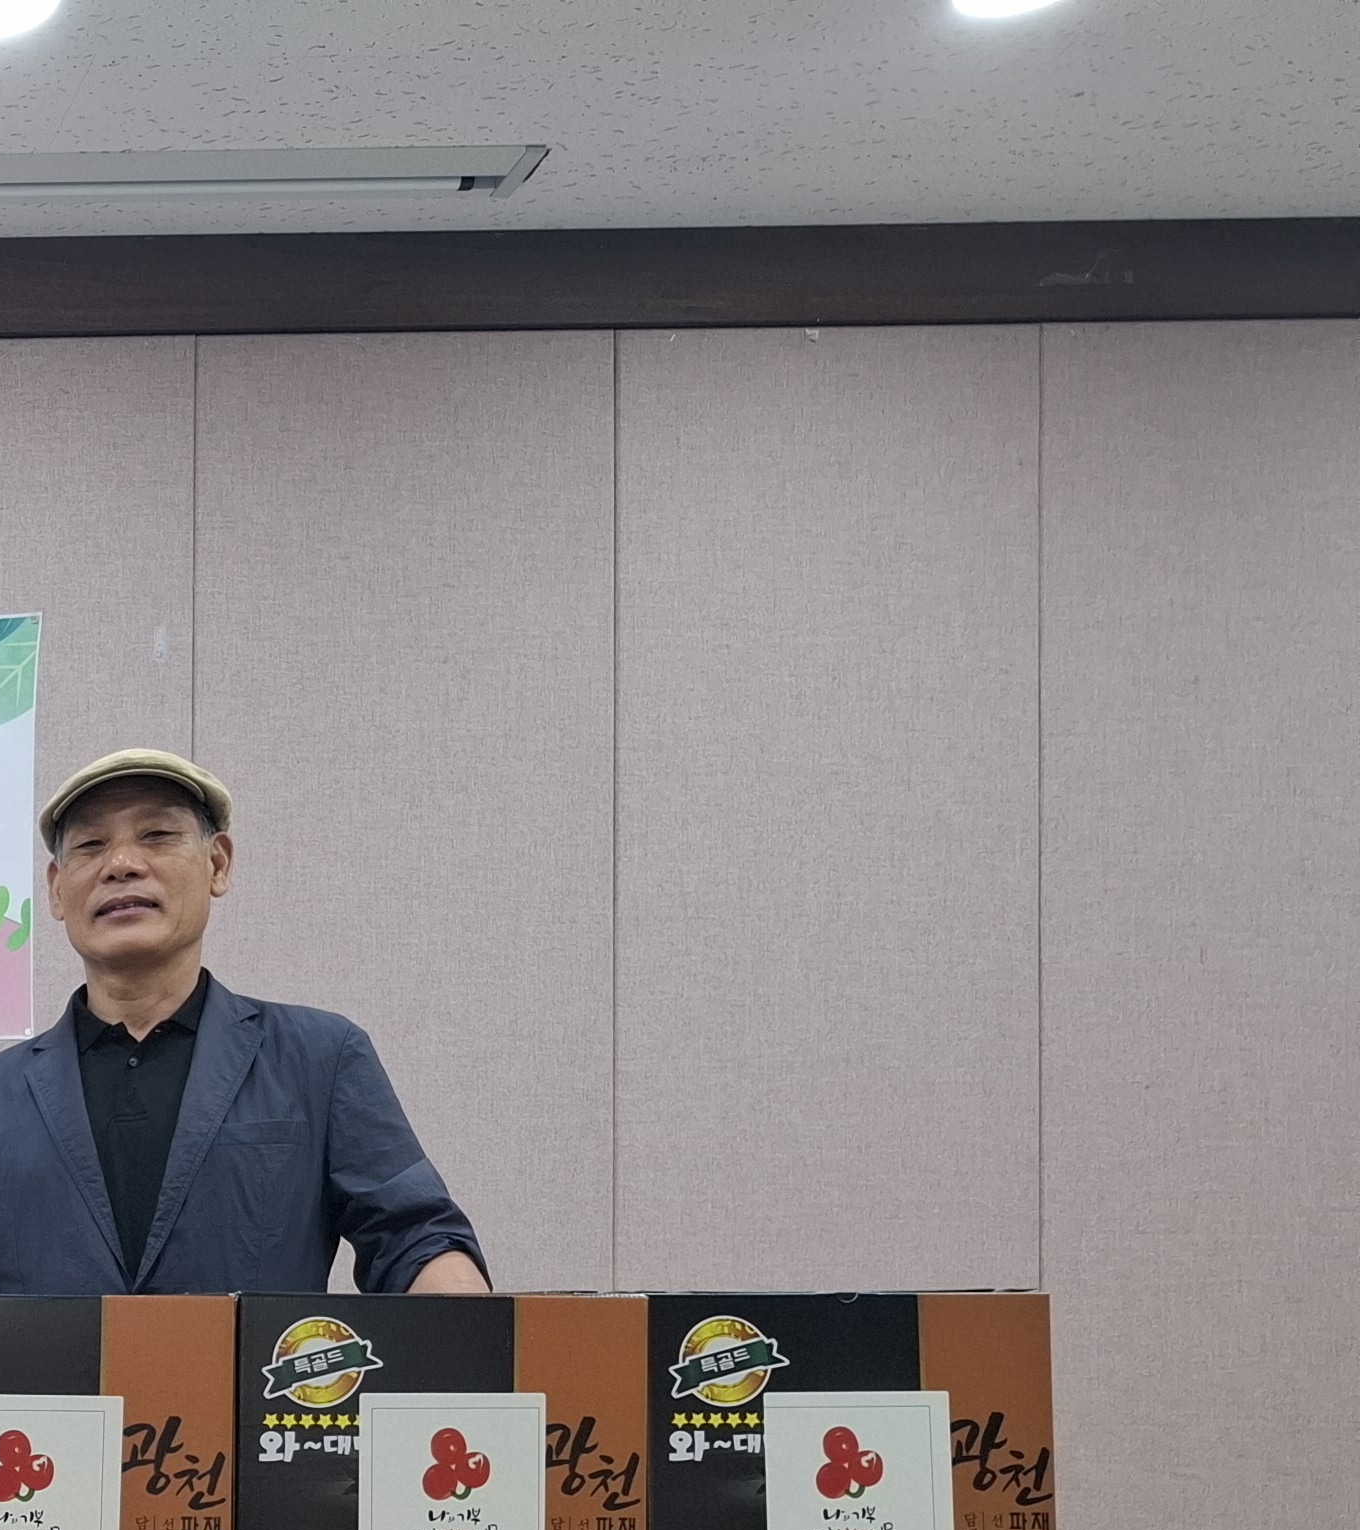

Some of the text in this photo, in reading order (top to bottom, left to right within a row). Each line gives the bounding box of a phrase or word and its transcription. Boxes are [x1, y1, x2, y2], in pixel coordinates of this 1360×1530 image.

[124, 1415, 226, 1510] 광천
[259, 1431, 359, 1463] 와~대
[546, 1416, 641, 1511] 광천
[669, 1430, 764, 1462] 와~대
[951, 1411, 1054, 1506] 광천
